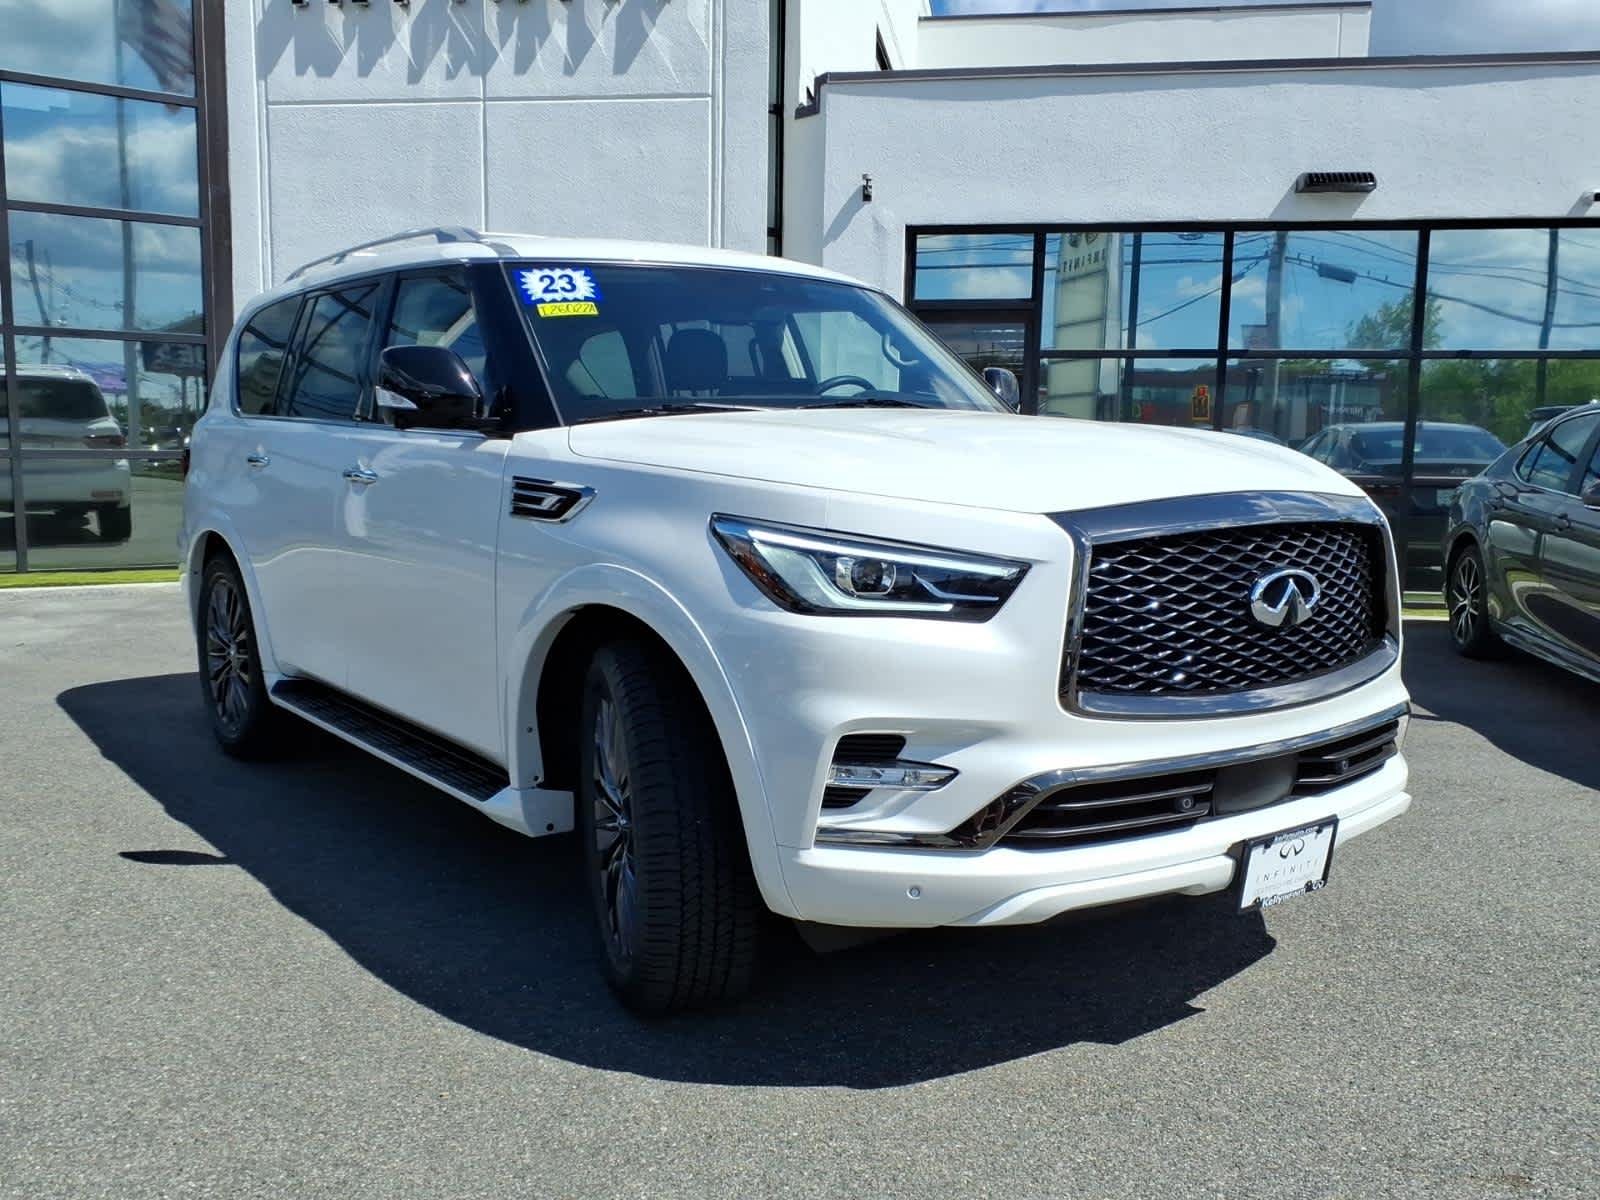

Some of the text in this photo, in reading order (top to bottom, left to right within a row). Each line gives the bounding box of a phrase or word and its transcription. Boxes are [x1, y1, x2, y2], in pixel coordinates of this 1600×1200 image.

[539, 274, 577, 294] 23
[1256, 858, 1319, 884] INFINITI
[1262, 894, 1283, 908] Kelly
